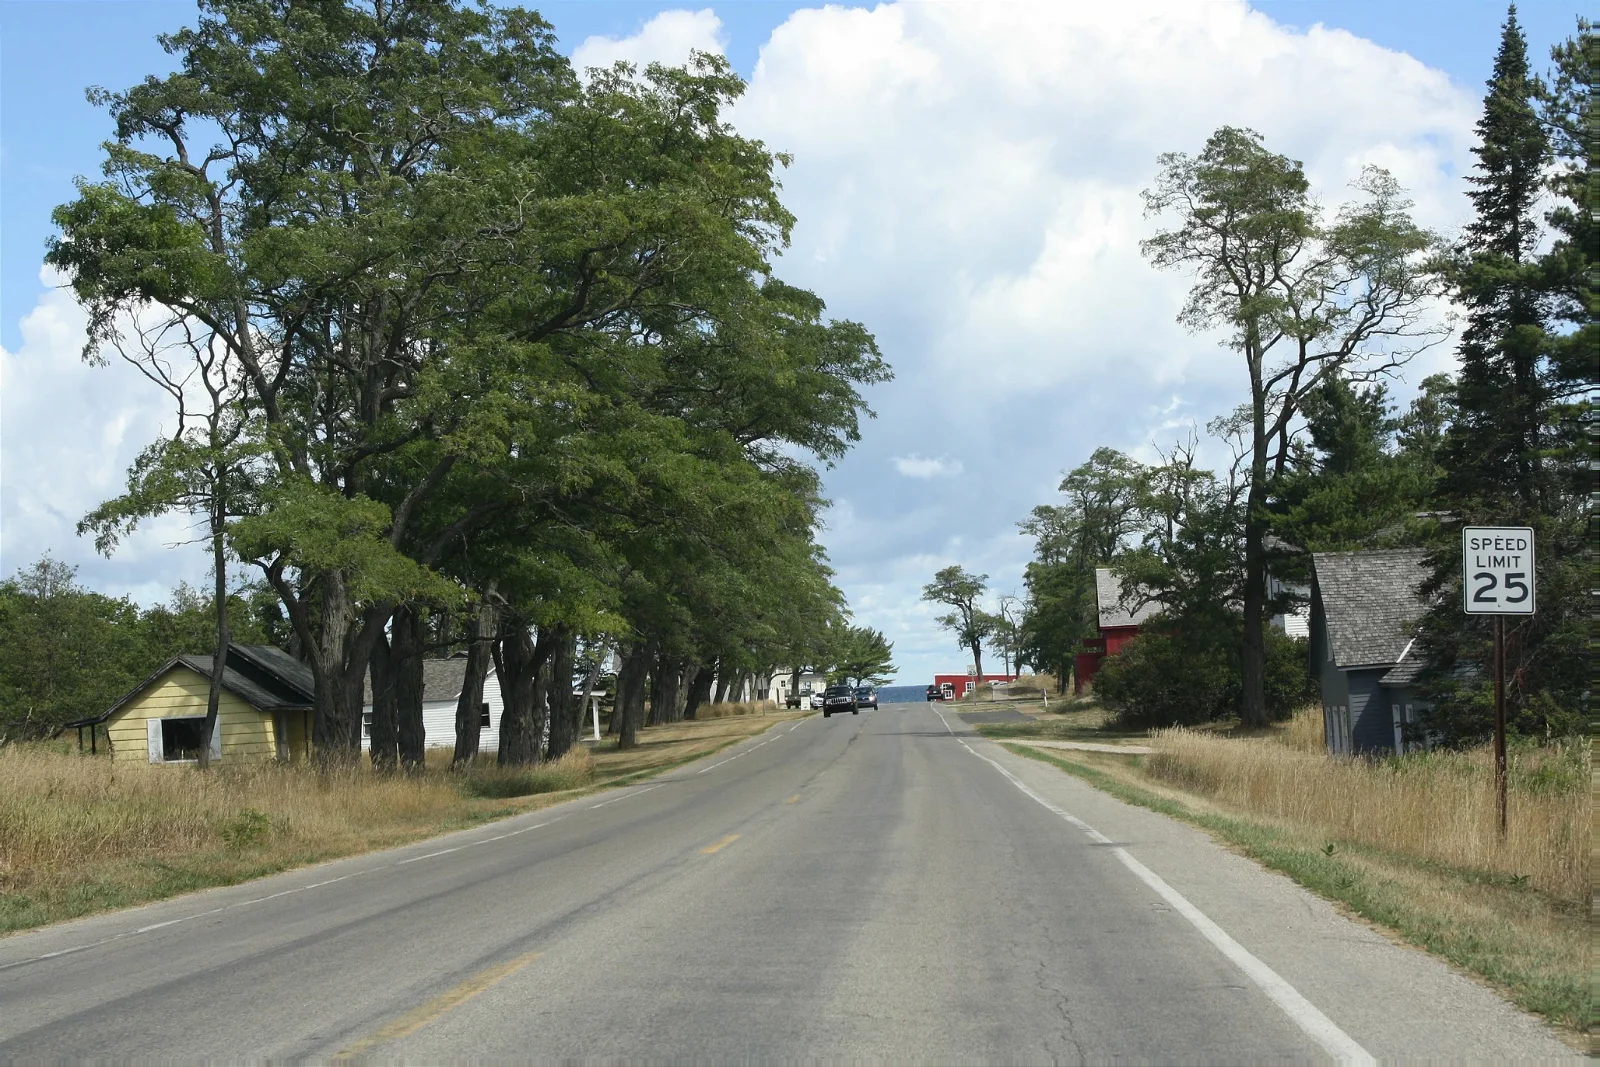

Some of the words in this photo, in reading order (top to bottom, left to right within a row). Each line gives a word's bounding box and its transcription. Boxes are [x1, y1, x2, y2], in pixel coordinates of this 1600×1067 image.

[1470, 537, 1527, 551] SPEED
[1476, 555, 1521, 568] LIMIT
[1473, 572, 1529, 603] 25
